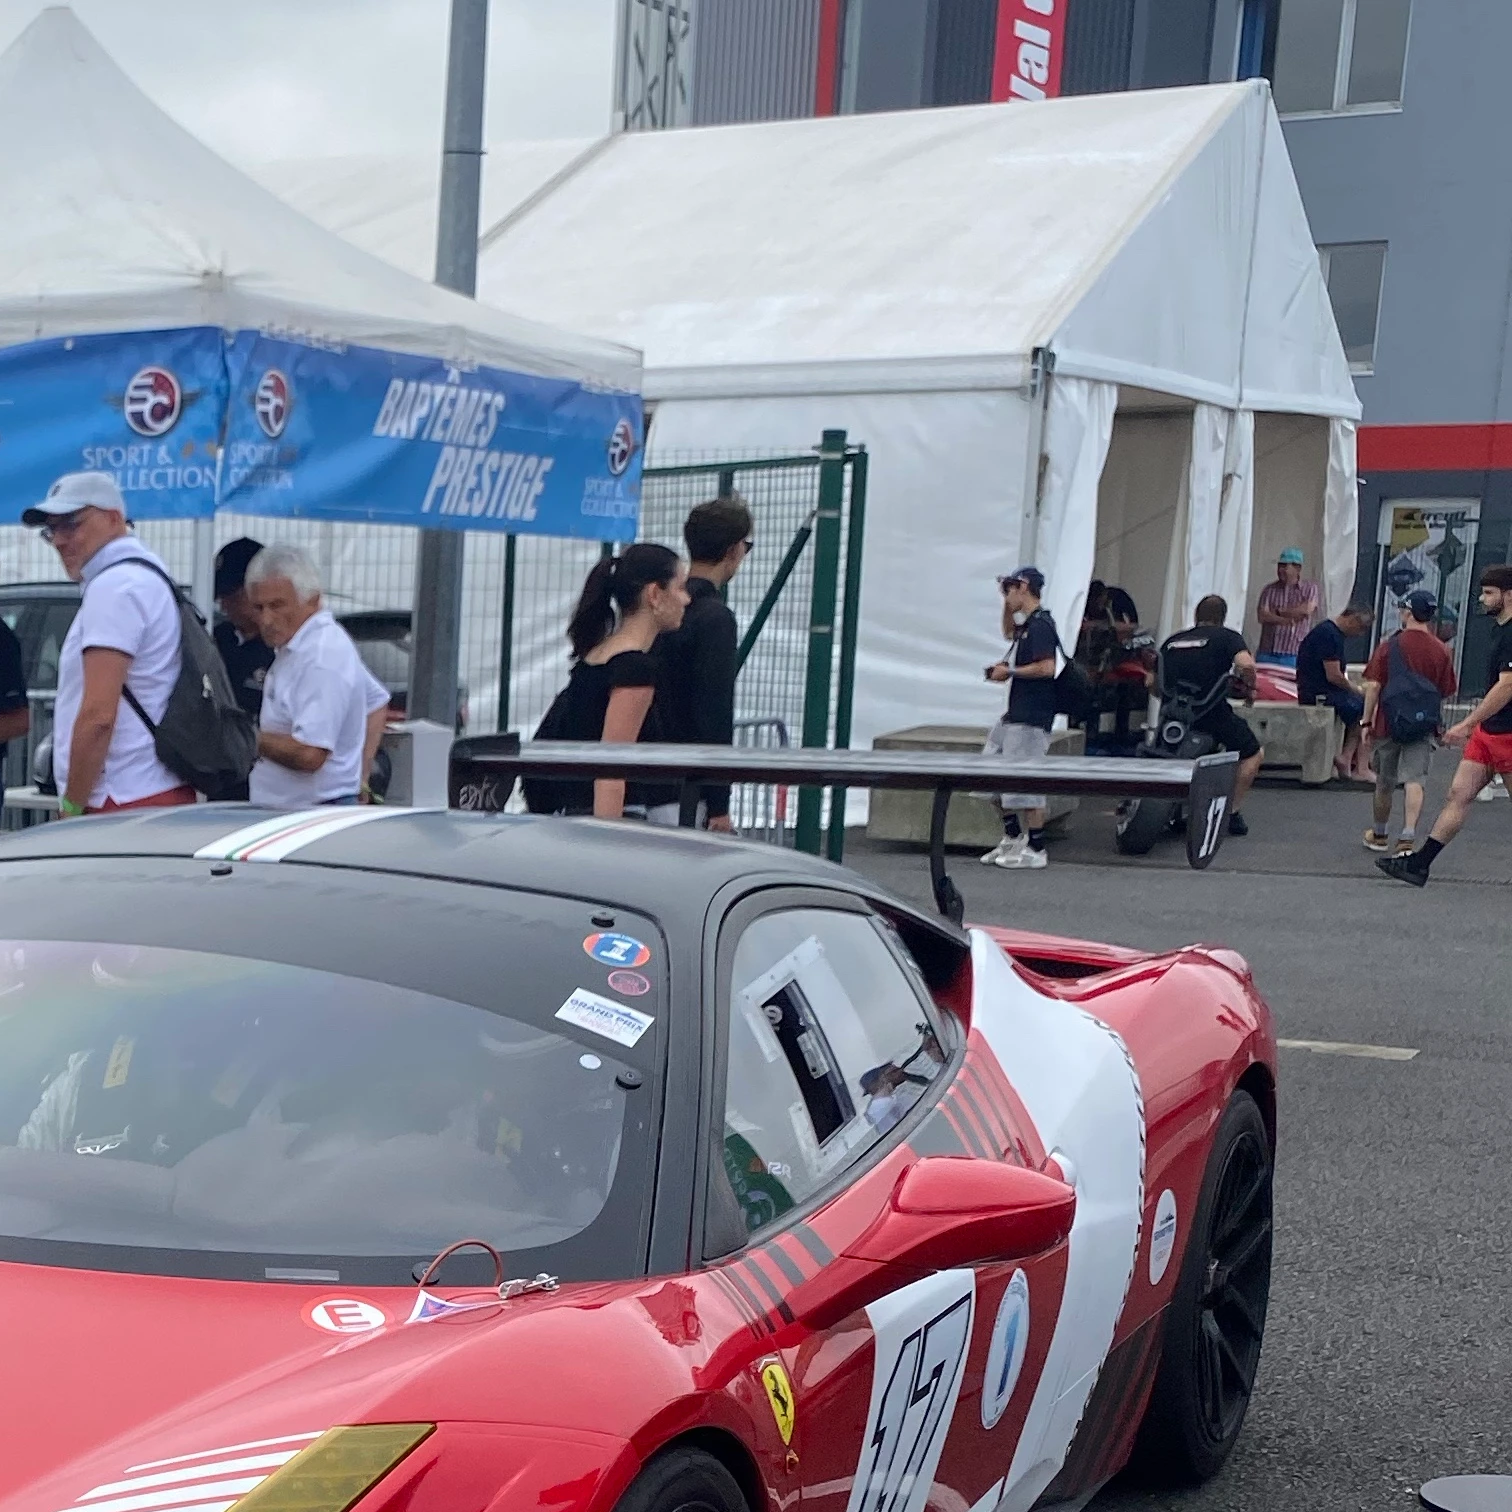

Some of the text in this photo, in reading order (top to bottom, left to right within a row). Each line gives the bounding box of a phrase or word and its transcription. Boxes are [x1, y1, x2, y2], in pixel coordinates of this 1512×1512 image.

[372, 366, 506, 447] BAPTÊMES
[82, 443, 150, 469] SPORT
[420, 446, 555, 522] PRESTIGE
[1198, 795, 1228, 859] 17
[569, 997, 614, 1021] GRAND
